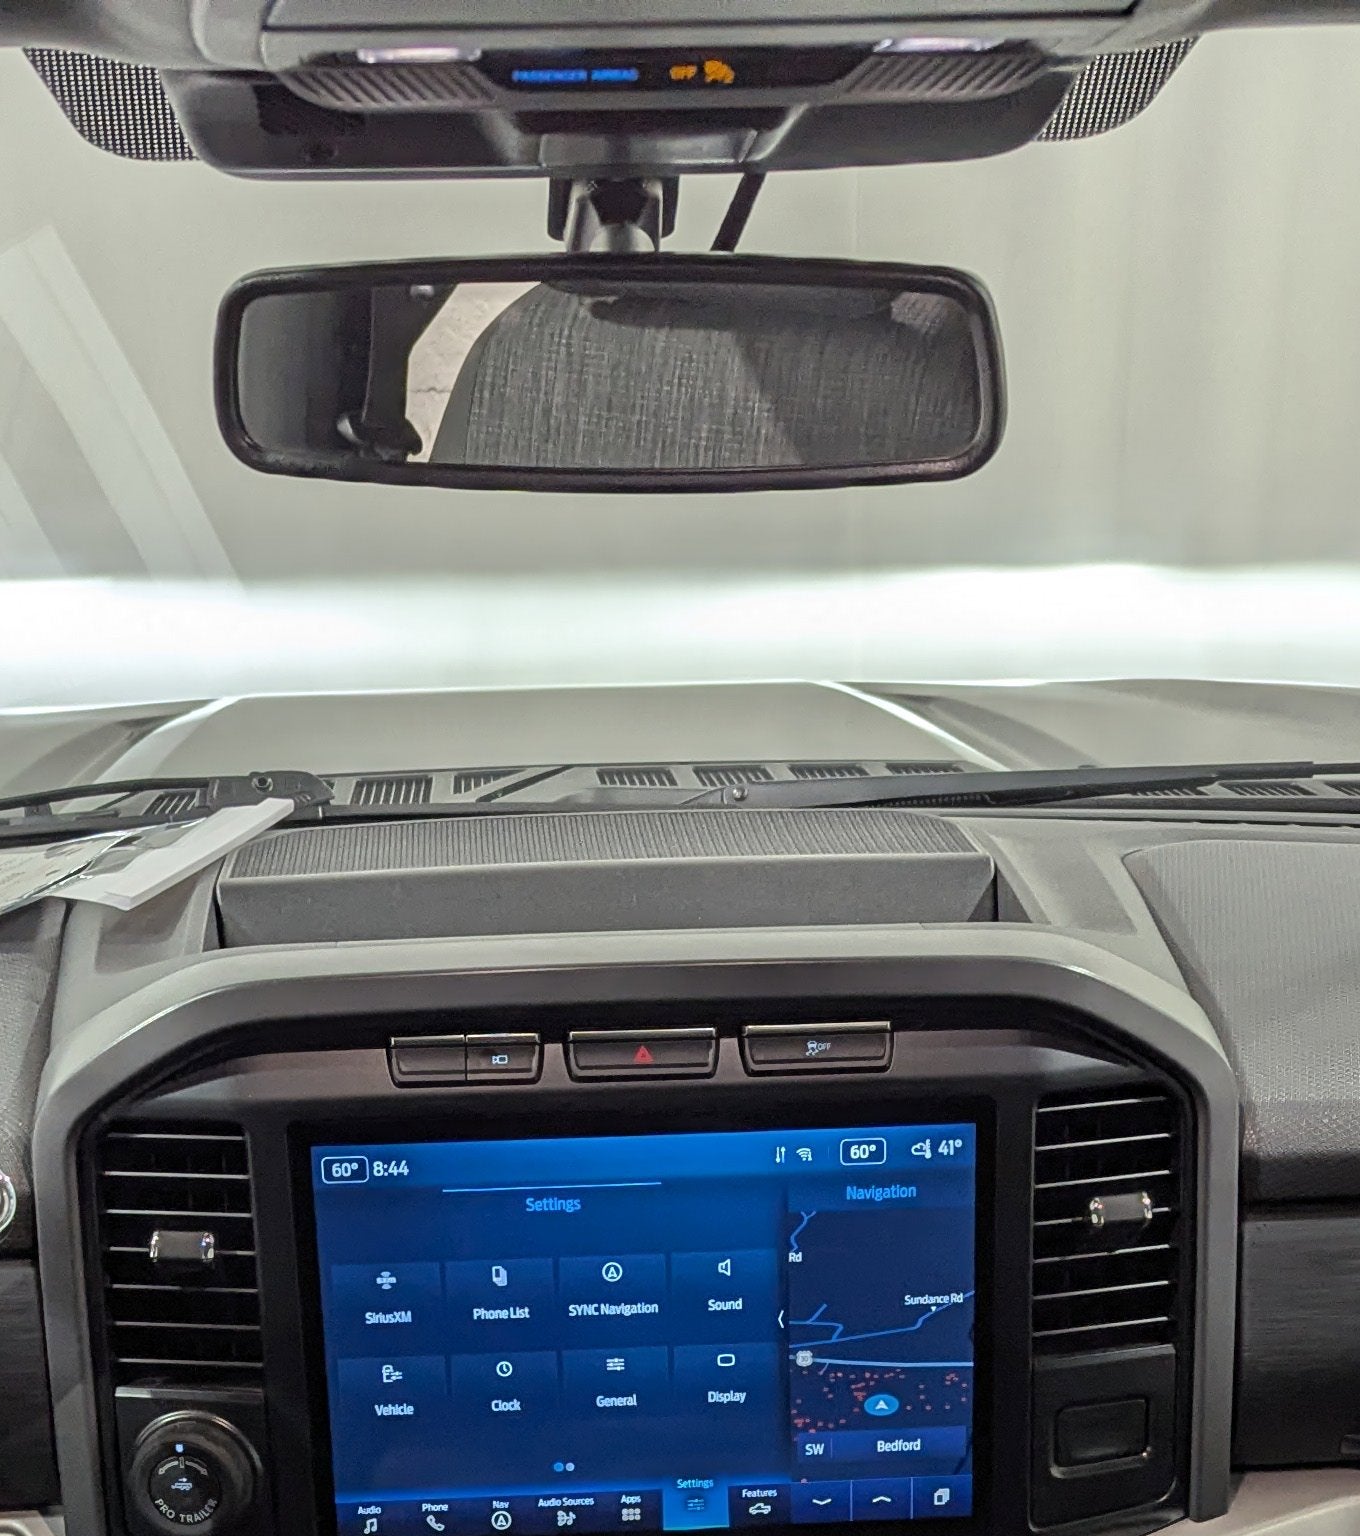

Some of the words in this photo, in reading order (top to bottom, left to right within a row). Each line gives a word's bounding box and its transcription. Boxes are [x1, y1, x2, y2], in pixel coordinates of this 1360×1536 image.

[850, 1144, 877, 1159] 60°
[937, 1139, 963, 1156] 41°
[331, 1161, 359, 1178] 60°
[372, 1160, 410, 1177] 8:44
[846, 1184, 917, 1202] Navigation
[525, 1197, 582, 1213] Settings
[788, 1251, 803, 1263] Rd
[707, 1297, 743, 1312] Sound
[904, 1294, 950, 1306] Sundance
[950, 1292, 964, 1304] Rd
[472, 1307, 509, 1321] Phone
[509, 1306, 530, 1320] List
[568, 1303, 599, 1317] SYNC
[600, 1301, 659, 1317] Navigation
[365, 1310, 413, 1325] SiriusXM
[595, 1393, 638, 1408] General
[707, 1390, 747, 1404] Display
[374, 1402, 414, 1417] Vehicle
[491, 1398, 522, 1413] Clock
[805, 1443, 825, 1456] SW
[876, 1438, 922, 1453] Bedford
[676, 1477, 715, 1490] Settings
[621, 1494, 642, 1505] Apps
[741, 1487, 778, 1499] Features
[421, 1502, 449, 1513] Phone
[492, 1499, 510, 1509] Nav
[538, 1497, 561, 1508] Audio
[562, 1495, 595, 1507] Sources
[154, 1498, 176, 1520] PRO
[179, 1498, 219, 1524] TRAILER
[357, 1505, 382, 1515] Audio
